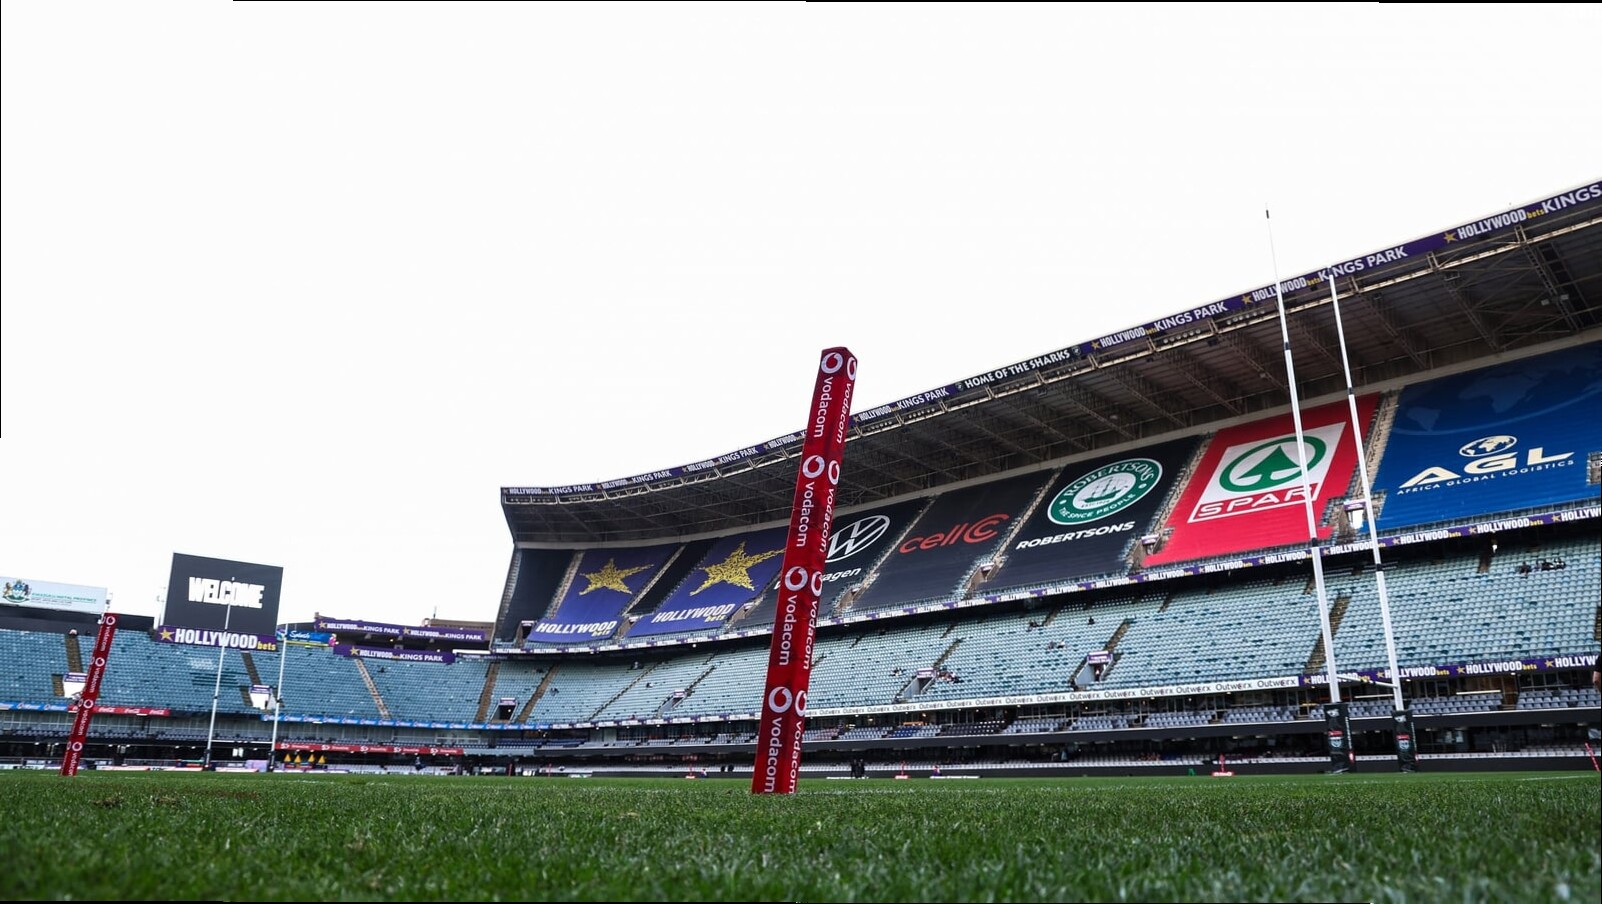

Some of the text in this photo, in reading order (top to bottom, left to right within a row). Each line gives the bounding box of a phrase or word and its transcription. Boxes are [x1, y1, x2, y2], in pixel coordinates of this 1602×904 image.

[1457, 184, 1602, 240] HOLLYWOOD bets KINGS
[1252, 277, 1307, 303] HOLLYWOOD
[1318, 259, 1364, 282] KNGS
[1366, 246, 1408, 267] PARK
[1100, 327, 1146, 348] HOLLYWOOD
[1154, 312, 1193, 331] KINGS
[1194, 301, 1228, 319] PARK
[965, 349, 1071, 389] HOME OF THE SHARKS
[814, 377, 834, 438] vodacom
[836, 383, 852, 444] vodacom
[859, 405, 891, 422] HOLLYWOOD
[897, 394, 925, 410] KINGS
[924, 387, 949, 402] PARK
[718, 452, 741, 464] KINGS
[740, 447, 759, 458] PARK
[1398, 447, 1576, 489] AGL
[548, 486, 572, 494] KINGS
[573, 484, 593, 492] PARK
[631, 474, 653, 484] KINGS
[653, 470, 672, 481] PARK
[1063, 462, 1155, 498] ROBERTSONS
[1397, 459, 1574, 496] AFRICA GLOBAL LOGISTICS
[796, 482, 815, 547] vodacom
[1096, 493, 1137, 515] PEOPLE
[1198, 487, 1312, 517] SPAR
[820, 488, 835, 553] vodacom
[1476, 518, 1530, 533] HOLLYWOOD
[1016, 521, 1136, 550] ROBERTSONS
[1330, 541, 1373, 555] HOLLYWOOD
[1400, 530, 1449, 544] HOLLYWOOD
[1204, 560, 1243, 573] HOLLYWOOD
[1265, 551, 1307, 564] HOLLYWOOD
[1149, 569, 1184, 581] HOLLYWOOD
[188, 577, 265, 608] WELCOME
[535, 620, 617, 634] HOLLYWOOD
[650, 603, 736, 624] HOLLYWOOD
[174, 628, 276, 651] HOLLYWOOD bets
[779, 595, 798, 666] vodacom
[803, 600, 818, 670] vodacom
[359, 649, 393, 658] HOLLYWOOD
[399, 653, 423, 661] KINGS
[1465, 661, 1522, 674] HOLLYWOOD
[1384, 666, 1436, 678] HLLYWOOD
[975, 698, 1002, 706] Outwerx
[1005, 696, 1033, 704] Outwerx
[1036, 694, 1066, 702] Outwerx
[1069, 692, 1100, 700] Outwerx
[1104, 690, 1136, 698] Outwerx
[1140, 688, 1173, 696] Outwerx
[1176, 685, 1211, 694] Outwerx
[1215, 682, 1252, 691] Outwerx
[1257, 679, 1296, 688] Outwerx
[764, 717, 783, 793] vodacom
[788, 721, 803, 794] vodacom
